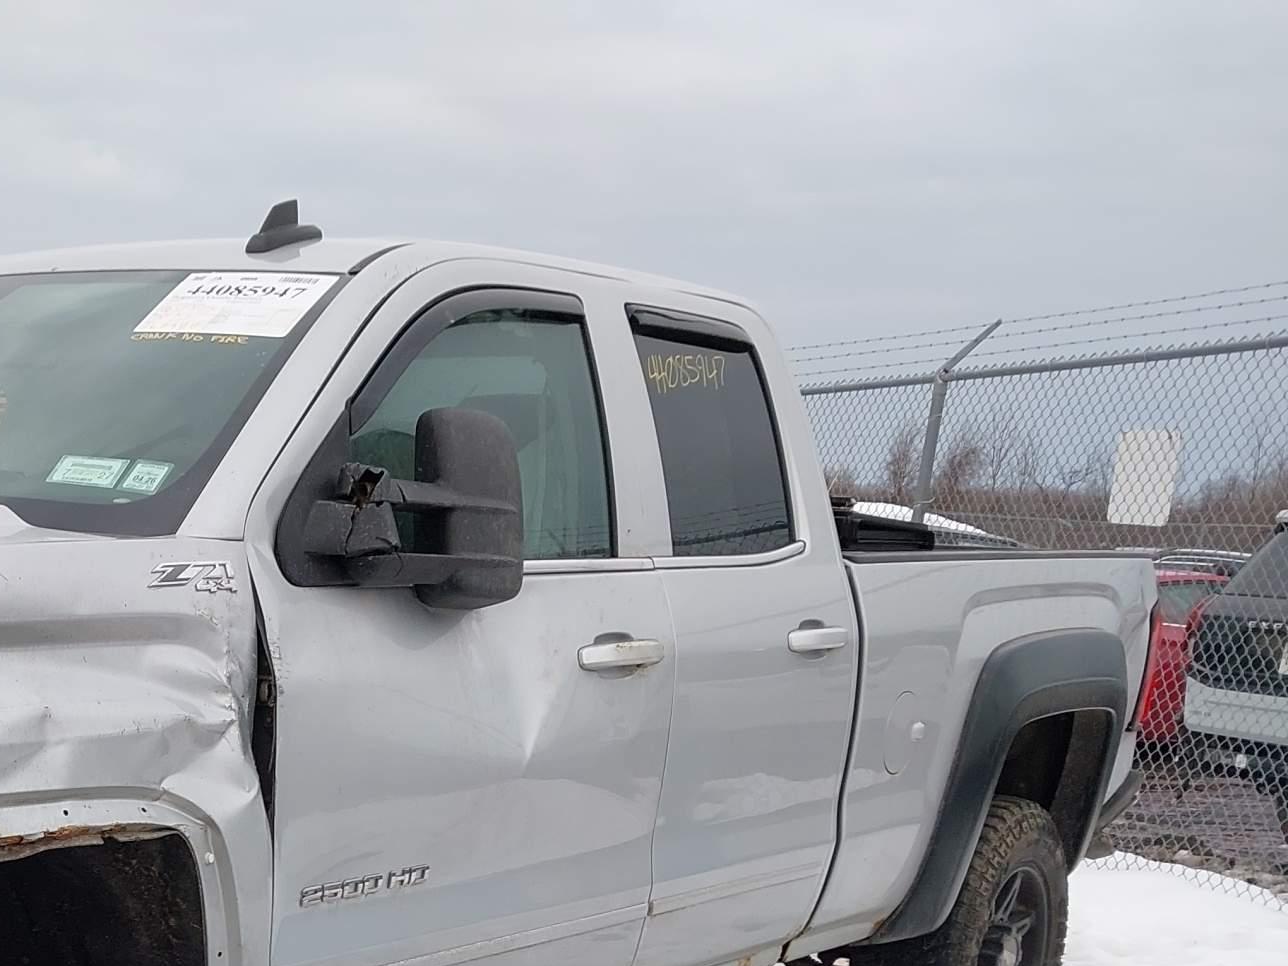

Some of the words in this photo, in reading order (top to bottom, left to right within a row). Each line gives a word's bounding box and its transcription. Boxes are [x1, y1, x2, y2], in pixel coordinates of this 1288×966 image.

[187, 284, 308, 299] 44085947
[182, 333, 204, 342] NO
[211, 335, 249, 345] FIRE
[648, 353, 726, 394] 44085947
[299, 873, 384, 908] 2500
[387, 864, 431, 889] HD
